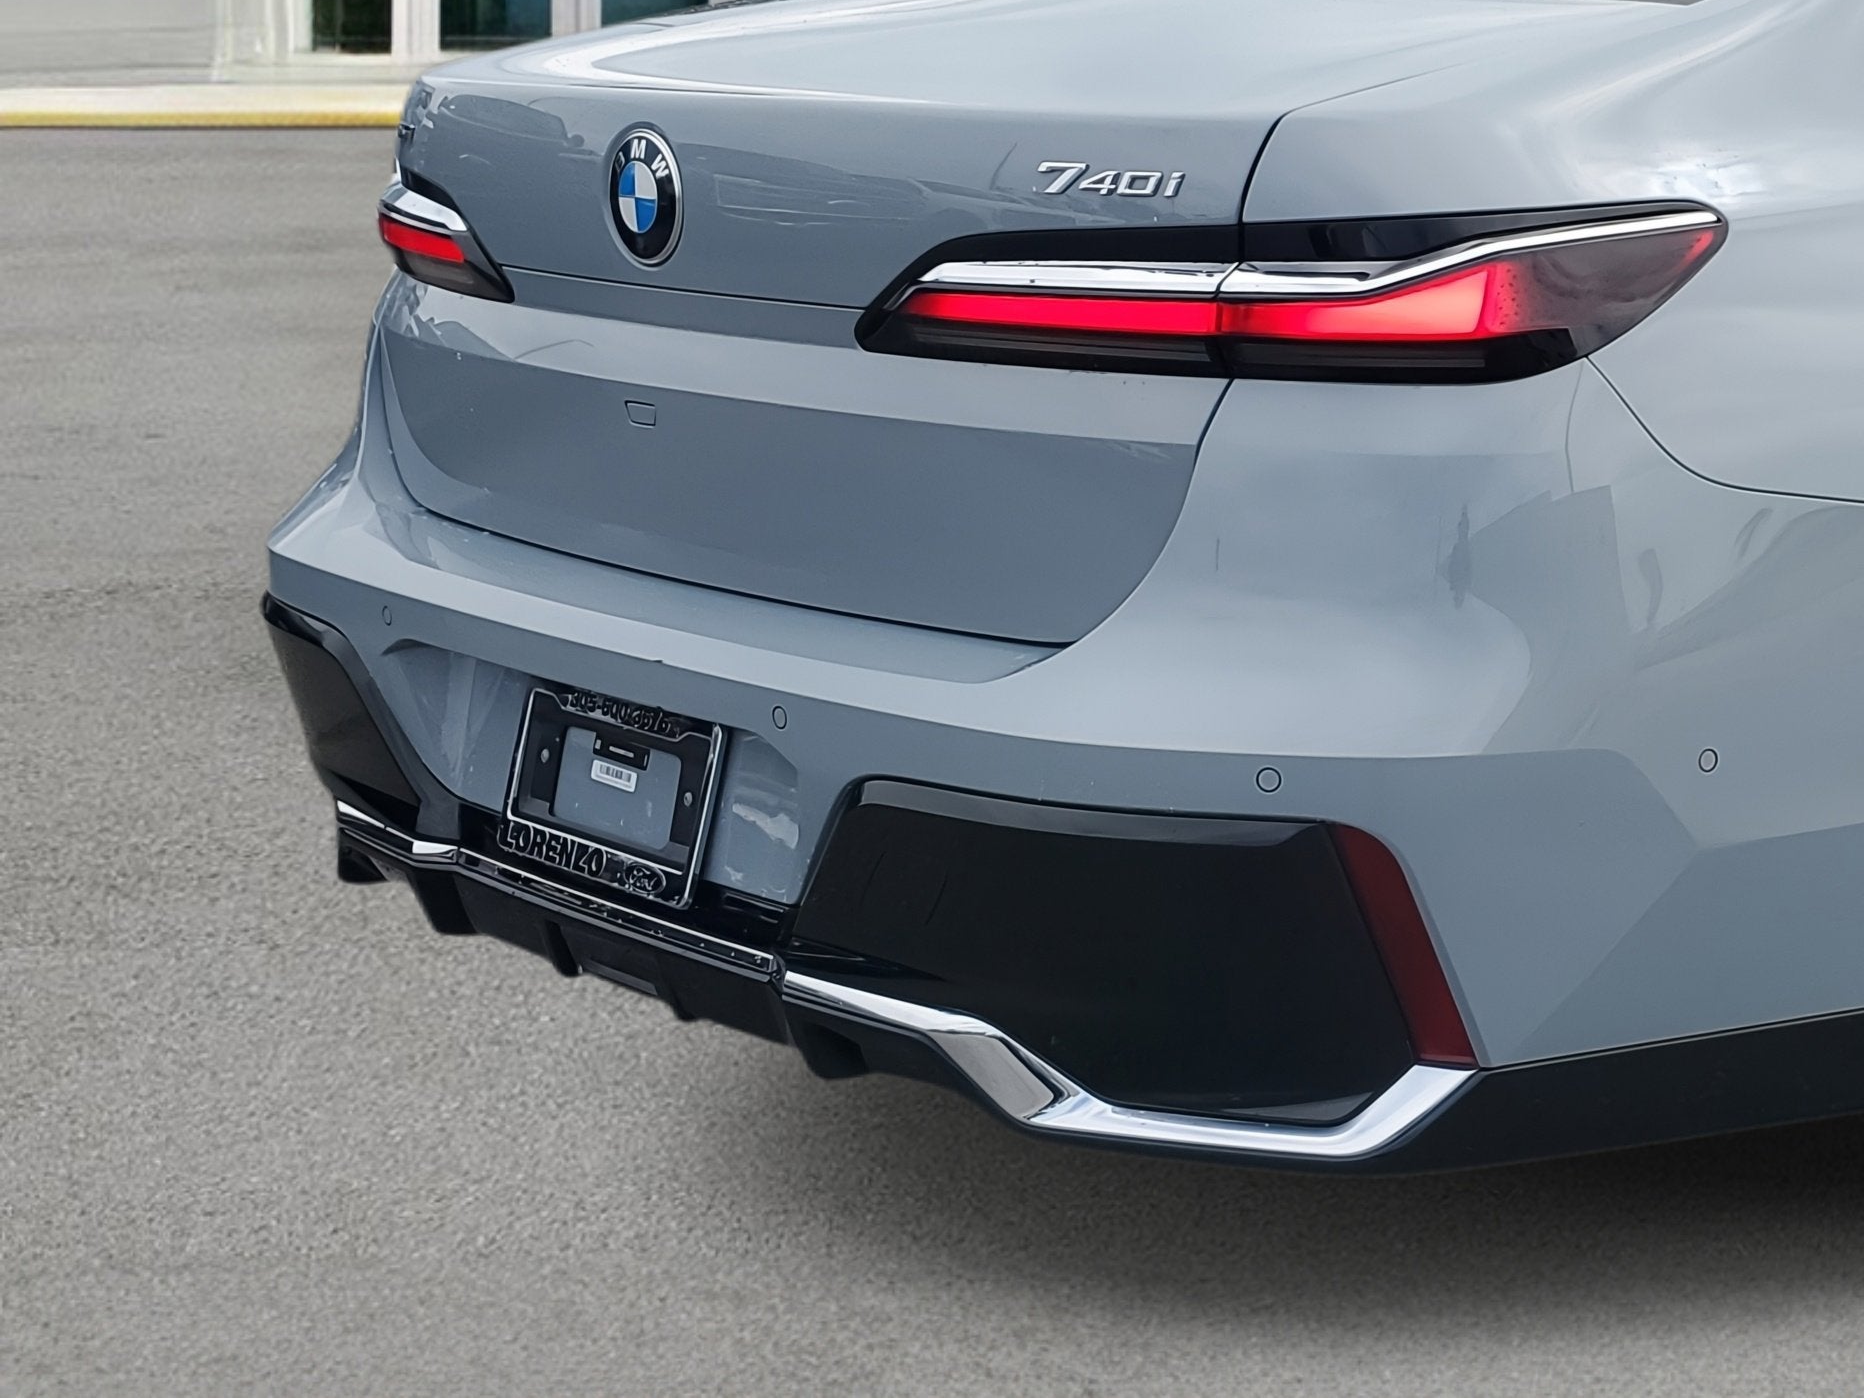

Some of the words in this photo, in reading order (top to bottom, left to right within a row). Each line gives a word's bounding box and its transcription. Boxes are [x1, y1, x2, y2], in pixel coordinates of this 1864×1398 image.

[615, 138, 670, 180] BMW
[1037, 160, 1186, 198] 740i
[498, 821, 608, 877] LORENZO
